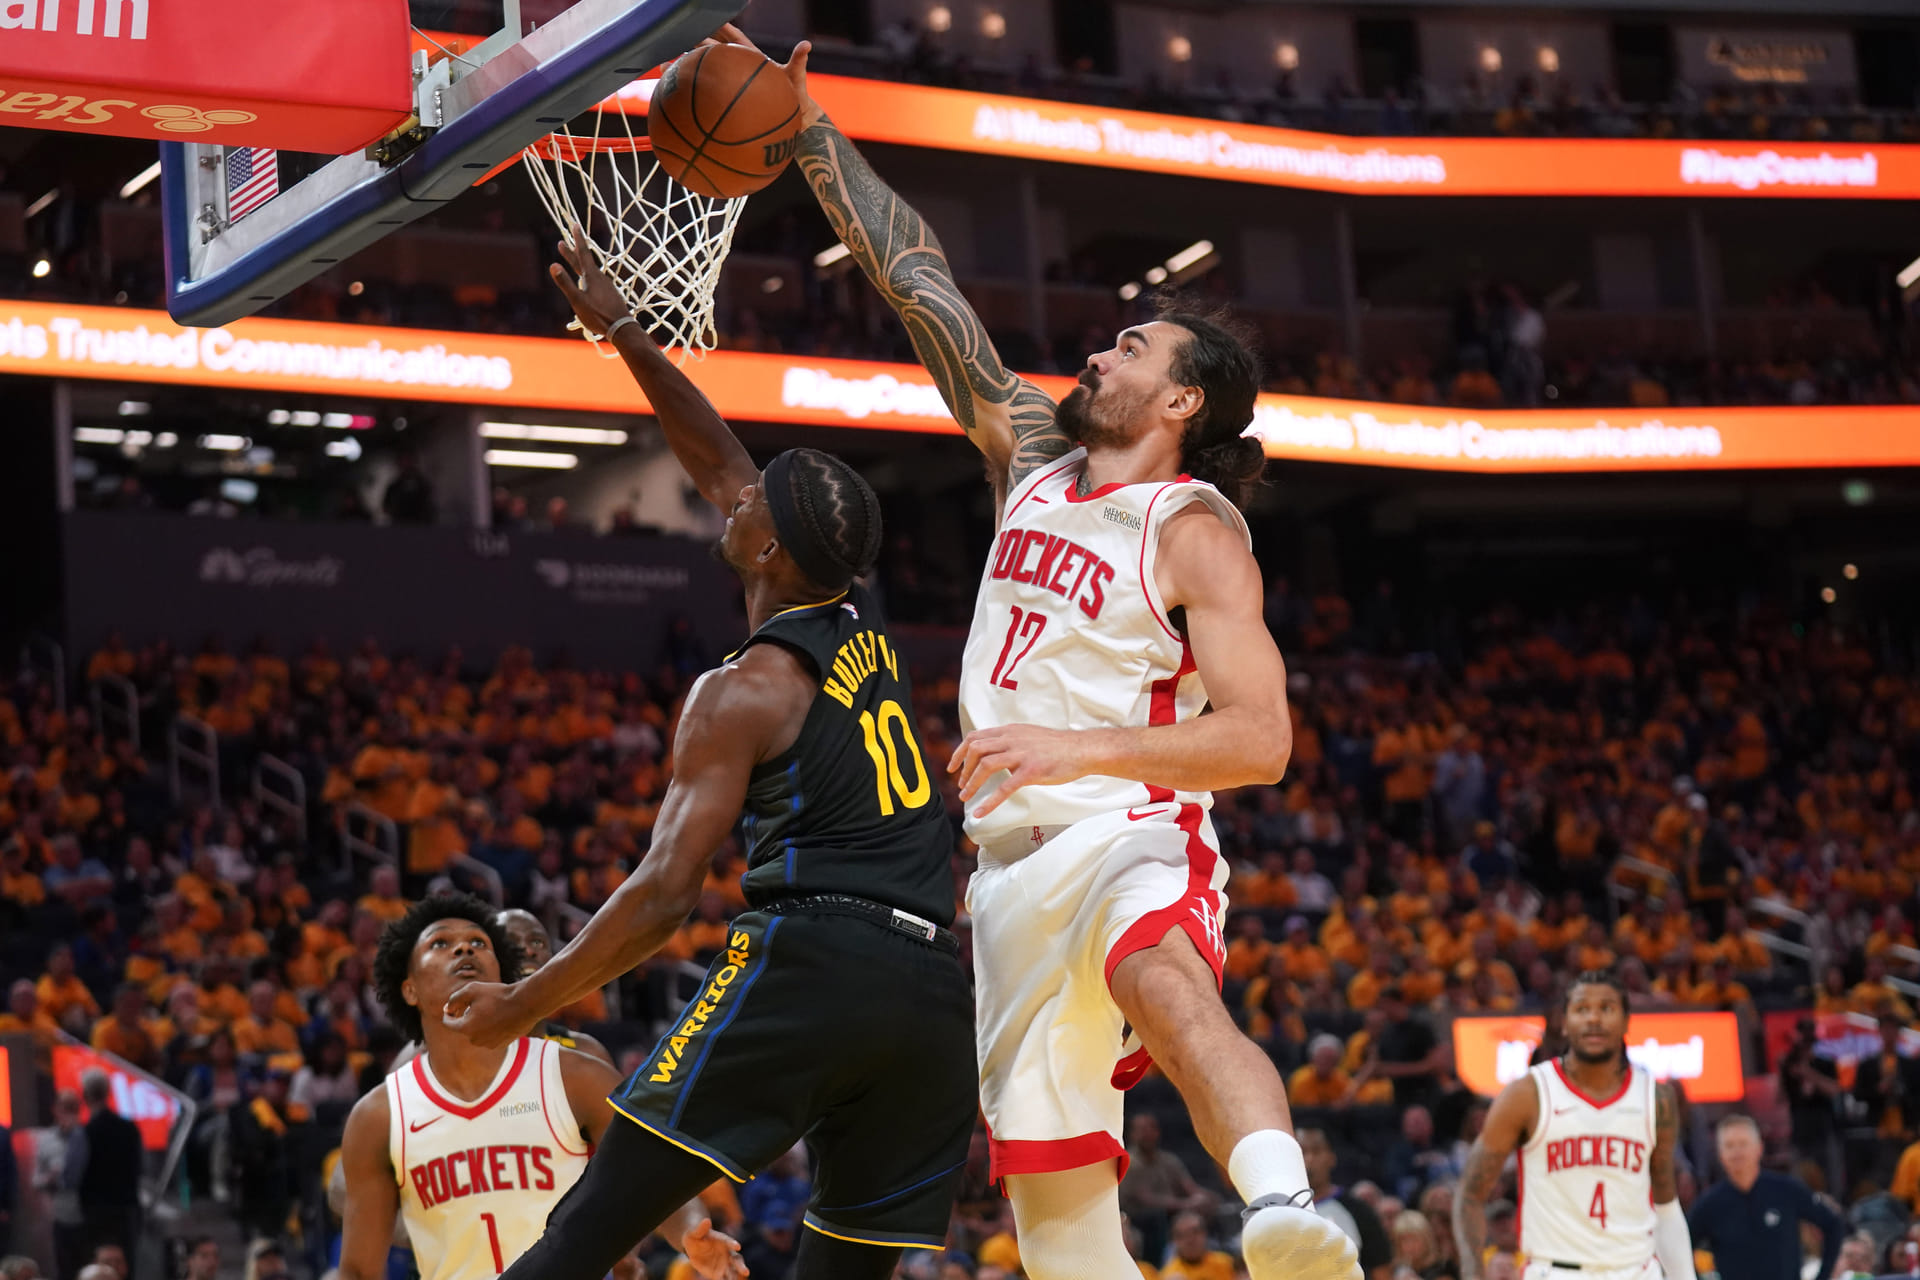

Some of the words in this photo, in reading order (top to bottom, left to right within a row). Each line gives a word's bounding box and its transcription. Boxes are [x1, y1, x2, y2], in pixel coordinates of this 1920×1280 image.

[0, 89, 138, 124] Sta
[1098, 118, 1208, 165] Trusted
[1208, 131, 1447, 184] Communications
[1681, 148, 1878, 190] RingCentral
[50, 317, 198, 368] Trusted
[200, 326, 513, 390] Communications
[1351, 412, 1461, 457] Trusted
[1461, 420, 1723, 459] Communications
[1103, 512, 1141, 531] HERMANN
[1104, 505, 1141, 525] MEMORIAL
[990, 605, 1047, 691] 12
[858, 700, 931, 816] 10
[649, 930, 750, 1083] WARRIORS
[409, 1144, 555, 1211] ROCKETS
[1546, 1136, 1646, 1174] ROCKETS
[1589, 1181, 1608, 1229] 4
[480, 1212, 504, 1275] 1
